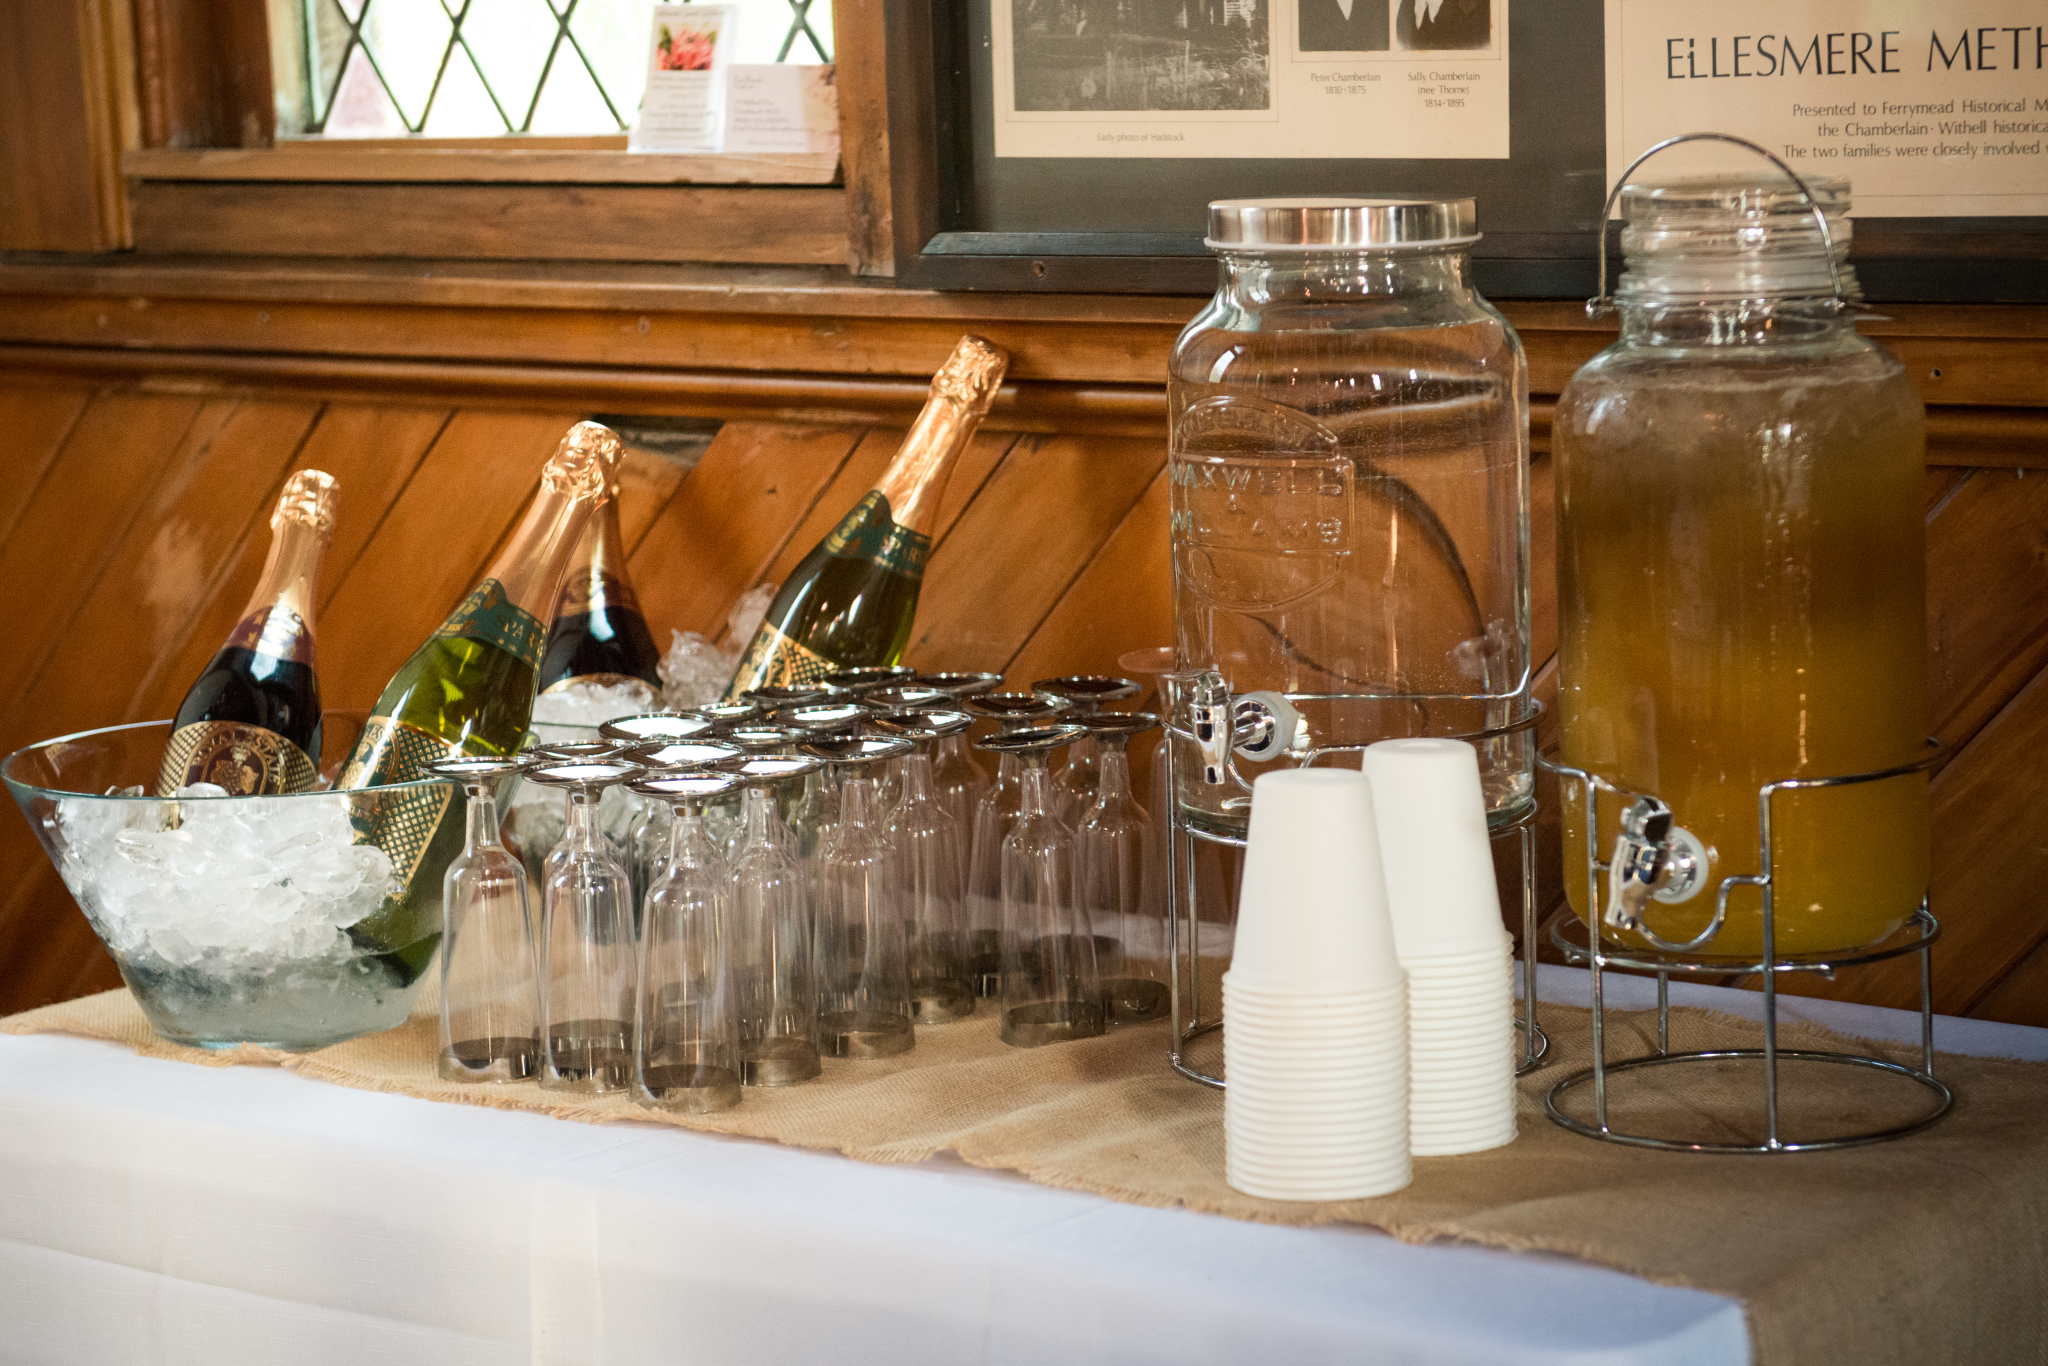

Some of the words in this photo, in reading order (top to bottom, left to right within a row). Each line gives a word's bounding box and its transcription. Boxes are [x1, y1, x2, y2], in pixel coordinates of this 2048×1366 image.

[1666, 31, 1901, 80] ELLESMERE
[1310, 72, 1330, 82] Peter
[1331, 72, 1382, 82] Chamberlain
[1407, 72, 1427, 84] Sally
[1428, 71, 1481, 81] Chamberlain
[1417, 85, 1436, 96] (nee
[1438, 85, 1470, 95] Thorne)
[1792, 101, 1856, 117] Presented
[1863, 104, 1877, 116] to
[1882, 99, 1954, 119] Ferrymead
[1962, 97, 2026, 114] Historical
[1818, 122, 1840, 137] the
[1783, 144, 1807, 158] The
[1813, 146, 1838, 158] two
[1843, 143, 1891, 158] families
[1895, 145, 1928, 157] were
[1932, 141, 1979, 160] closely
[1983, 140, 2040, 156] involved
